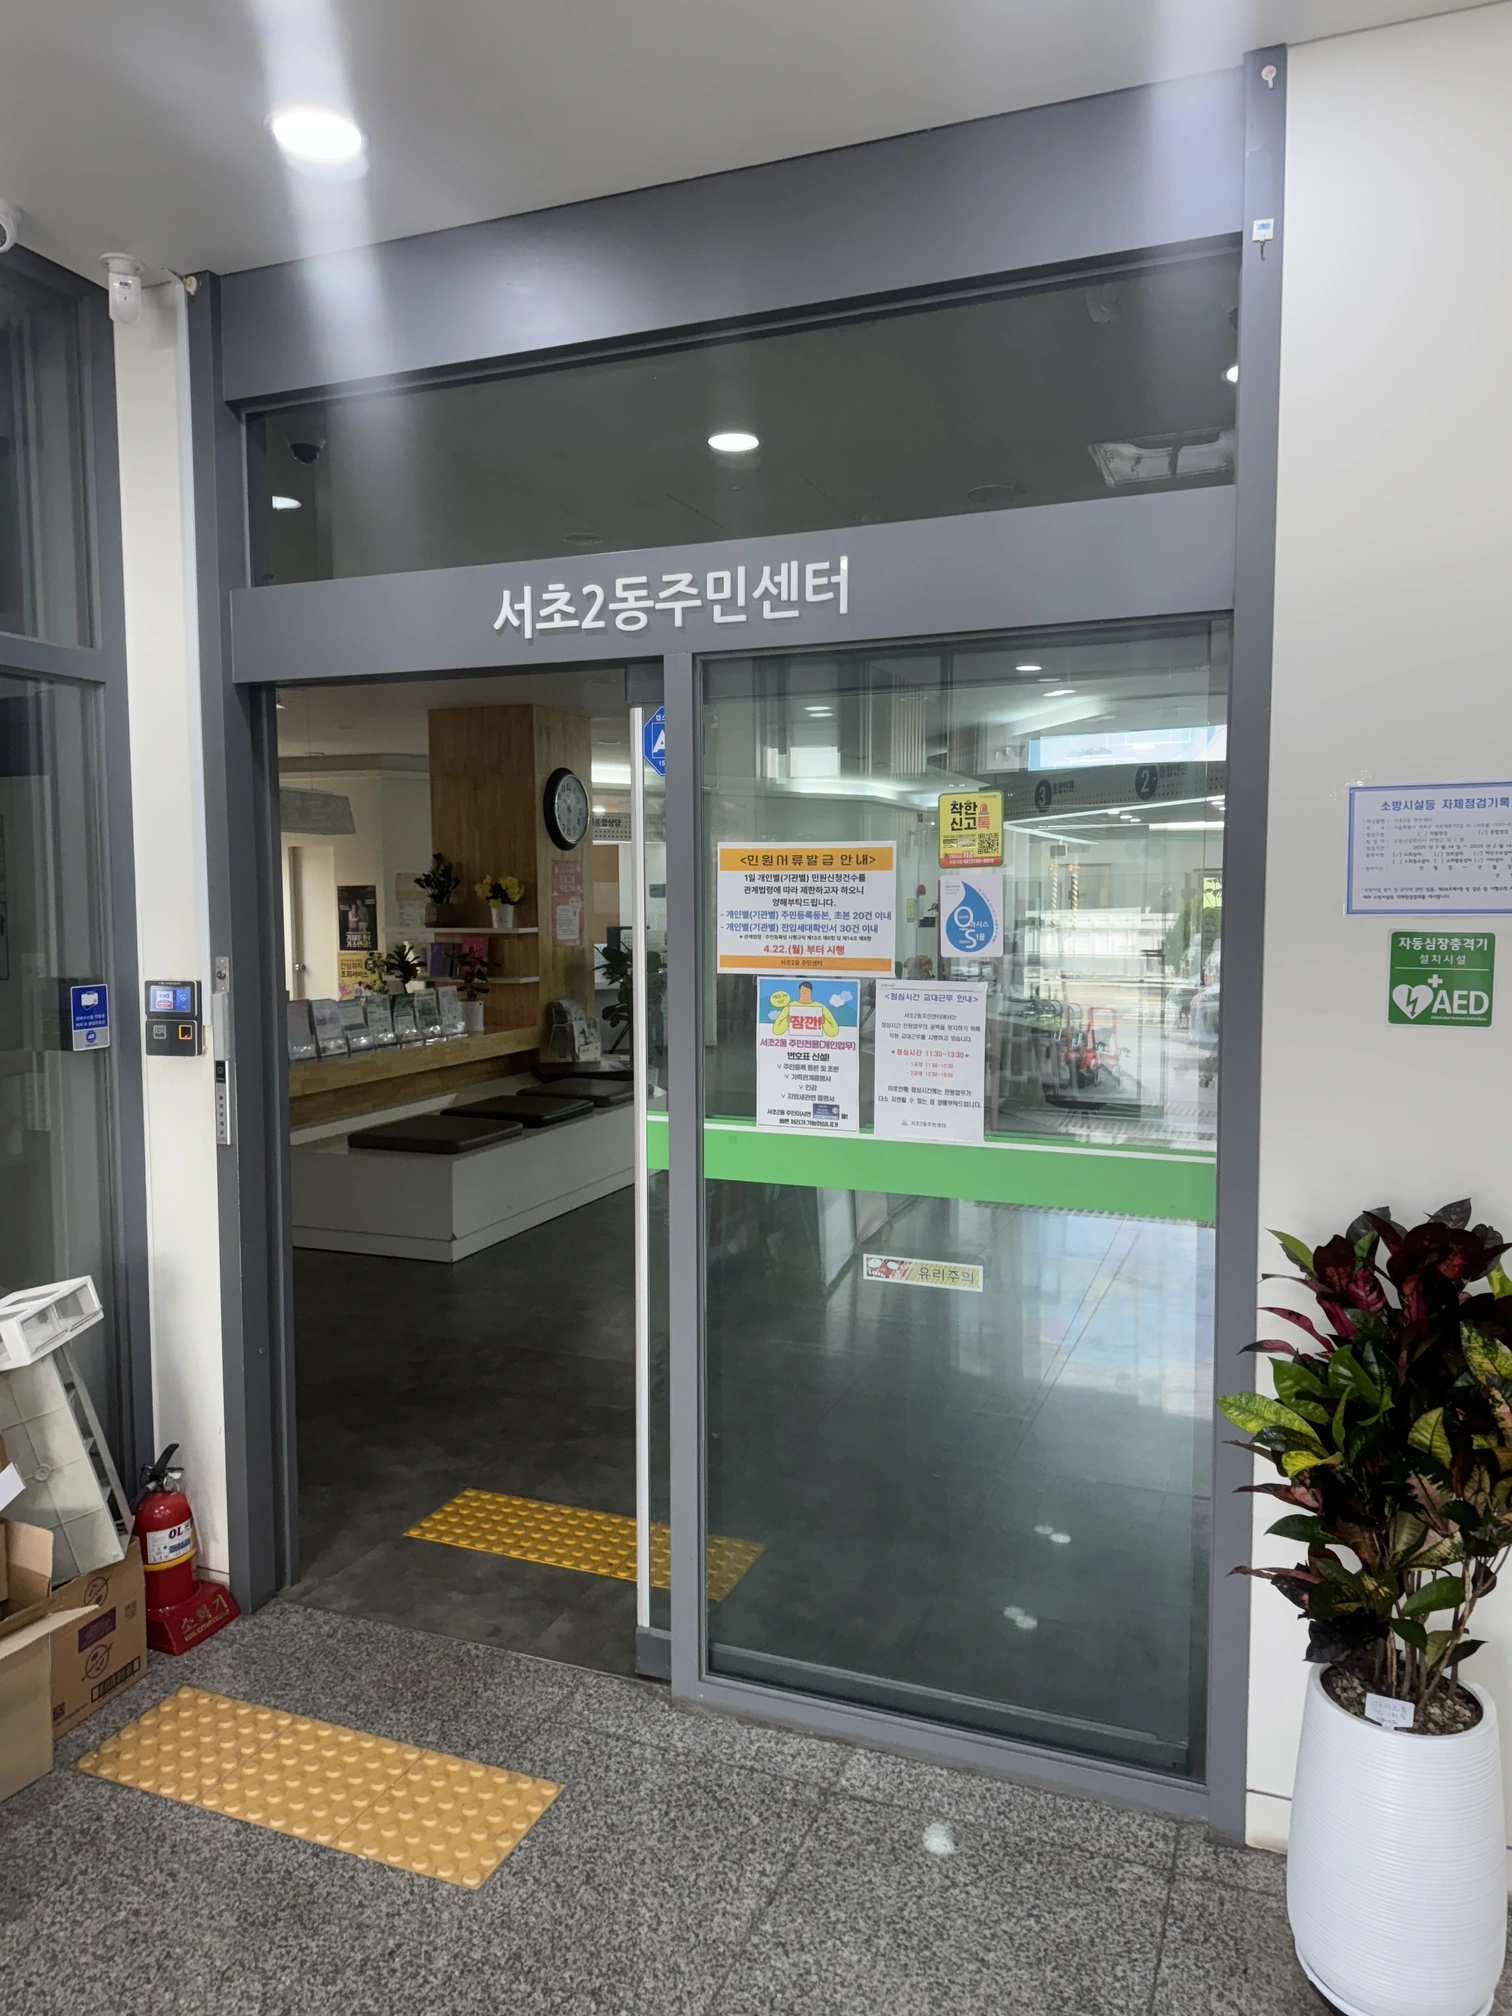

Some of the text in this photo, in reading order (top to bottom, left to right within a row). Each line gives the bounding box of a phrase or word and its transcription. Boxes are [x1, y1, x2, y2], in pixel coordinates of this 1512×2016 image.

[493, 555, 849, 639] 서초2동주민센터
[1140, 769, 1150, 793] 2
[1037, 786, 1046, 806] 3
[950, 800, 978, 816] 착한
[1380, 797, 1512, 812] 소방시설등 자체점검기록
[593, 817, 622, 828] 종합상담
[963, 851, 974, 859] 112
[744, 873, 867, 883] 1일 개인별(기관별) 민원신청건수를
[743, 885, 864, 895] 관계법령에 따라 제한하고자 하오니
[772, 898, 837, 907] 양해부탁드립니다.
[726, 910, 892, 921] 개인별(기관별) 주민등록등본, 초본 20건 이내
[726, 923, 879, 934] 개인별(기관별) 전입세대확인서 30건 이내
[1398, 937, 1488, 951] 자동심장충격기
[763, 944, 845, 956] 4.22.(월) 부터 시행
[1419, 954, 1466, 965] 설치시설
[923, 993, 954, 1003] 교대근무
[957, 994, 979, 1003] 안내>
[1431, 989, 1490, 1015] AED
[791, 1015, 823, 1030] 잠깐!
[759, 1038, 787, 1048] 서초2동
[787, 1052, 830, 1062] 번호표 신설!
[917, 1266, 974, 1285] 유리주의
